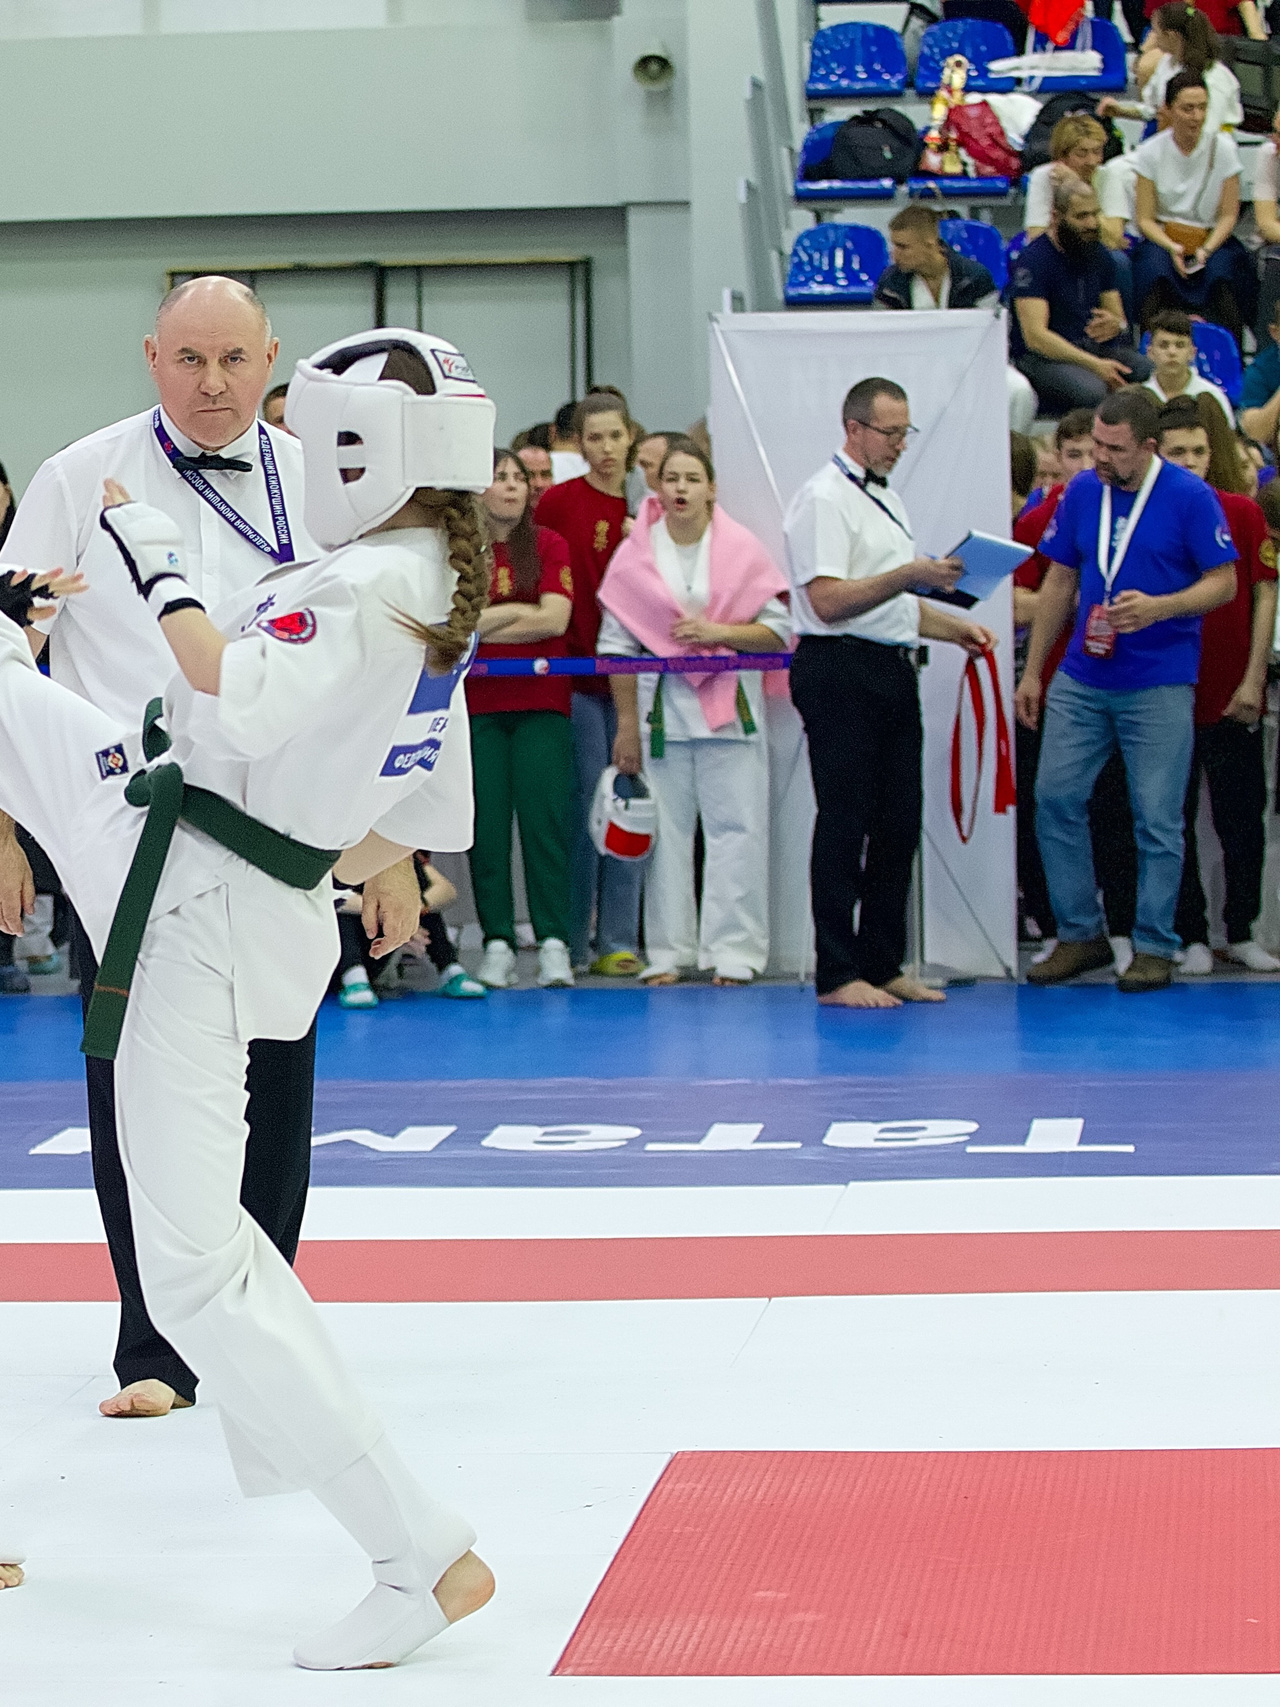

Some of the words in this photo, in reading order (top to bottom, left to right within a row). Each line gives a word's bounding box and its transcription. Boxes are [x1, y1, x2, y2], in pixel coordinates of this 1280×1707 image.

[259, 434, 276, 476] ФЕДЕРАЦИЯ
[202, 488, 239, 522] КИОКУШИН
[267, 475, 284, 515] КИОКУШИН
[233, 519, 272, 553] ФЕДЕРАЦИЯ
[275, 515, 290, 545] РОССИИ
